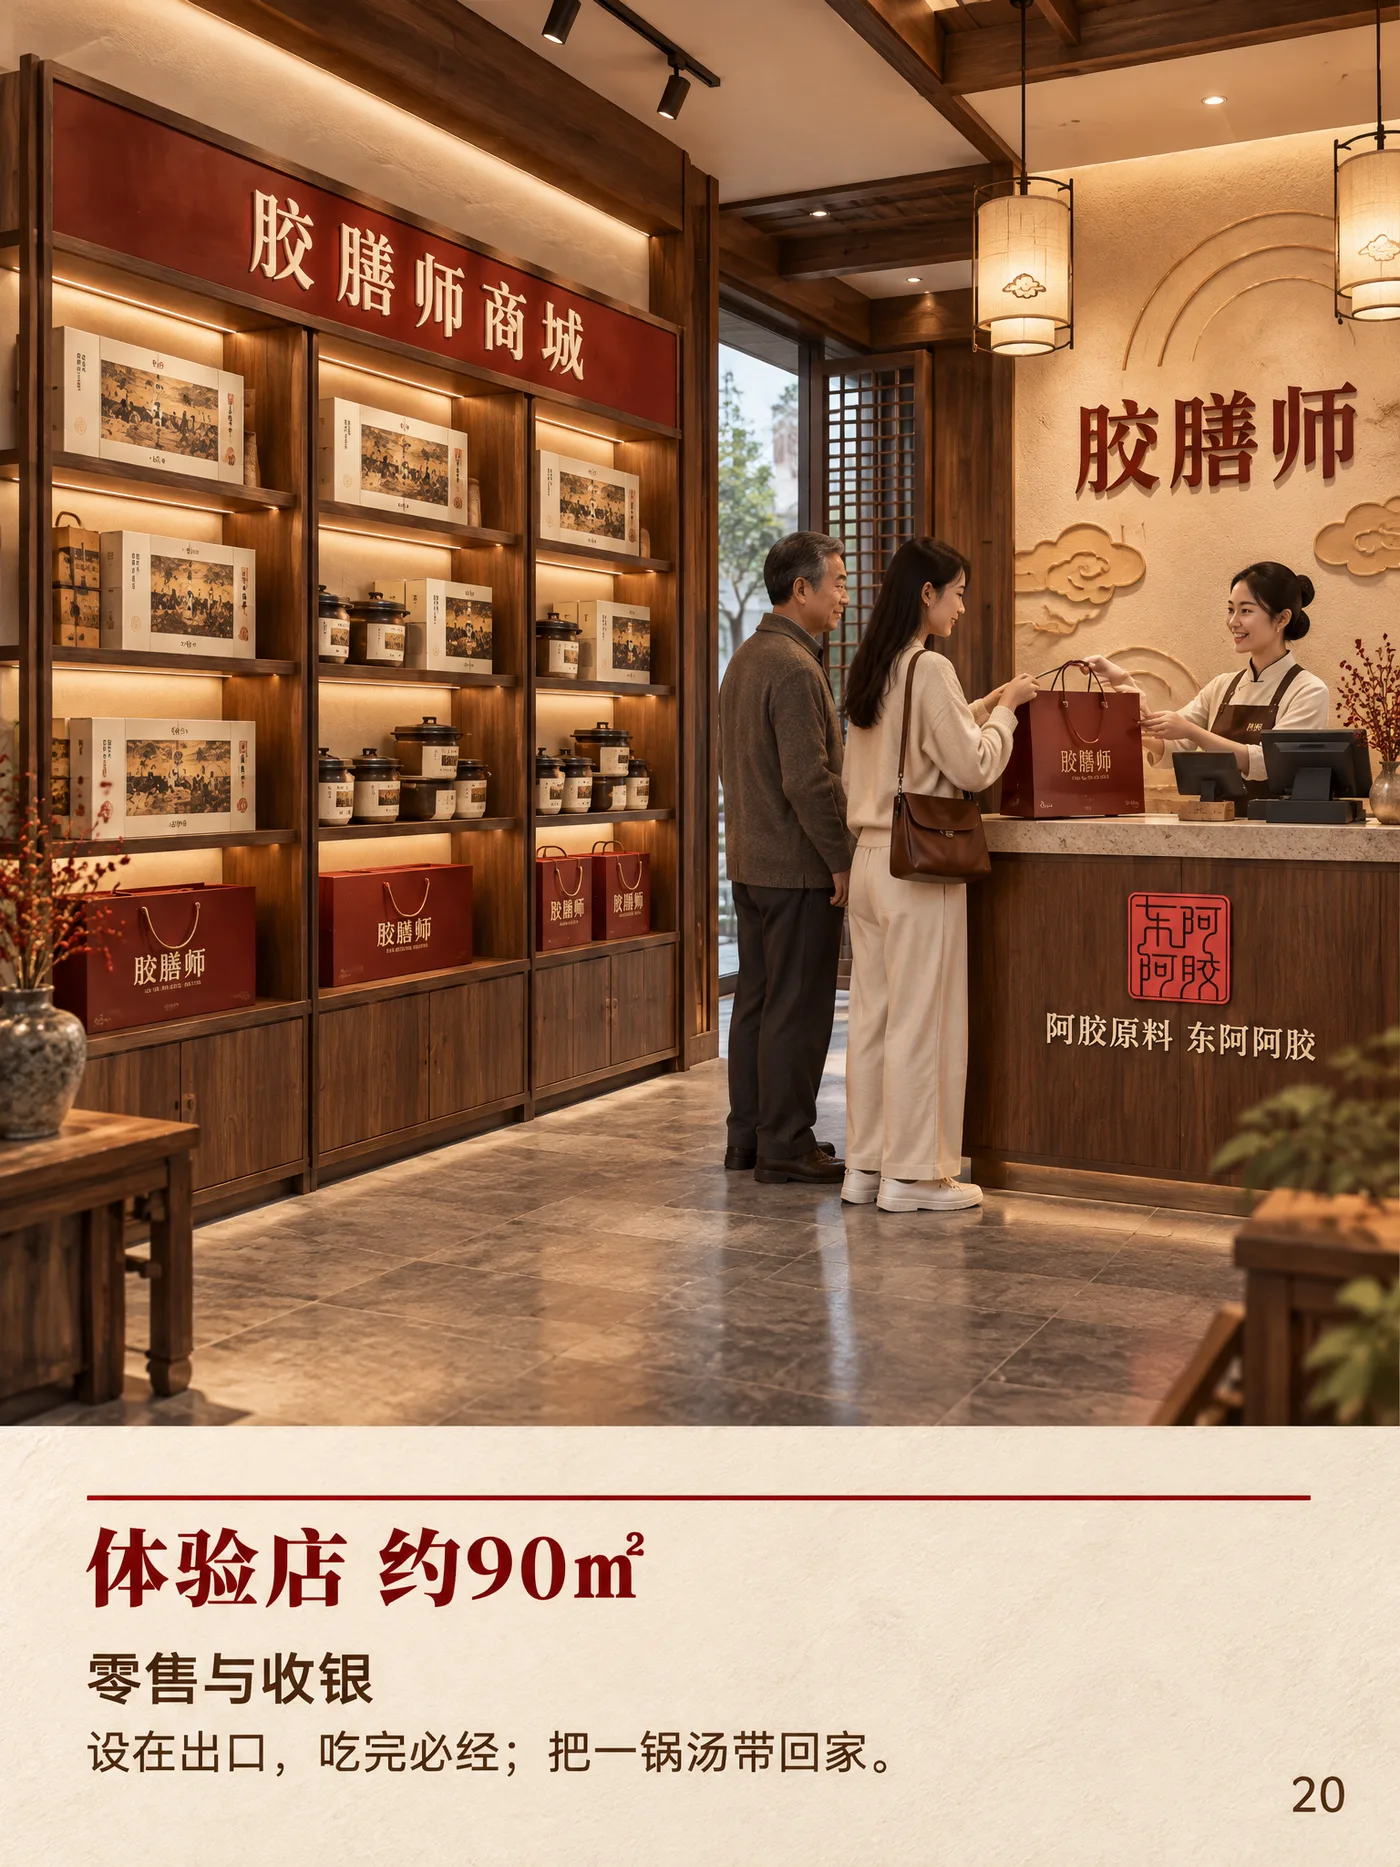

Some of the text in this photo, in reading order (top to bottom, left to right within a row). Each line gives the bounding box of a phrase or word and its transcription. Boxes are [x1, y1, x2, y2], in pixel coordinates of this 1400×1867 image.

[250, 189, 585, 380] 胶膳师商城
[1075, 381, 1358, 494] 胶膳师
[377, 917, 432, 947] 胶膳师
[133, 948, 206, 986] 胶膳师
[1046, 1012, 1316, 1061] 阿胶原料 东阿阿胶
